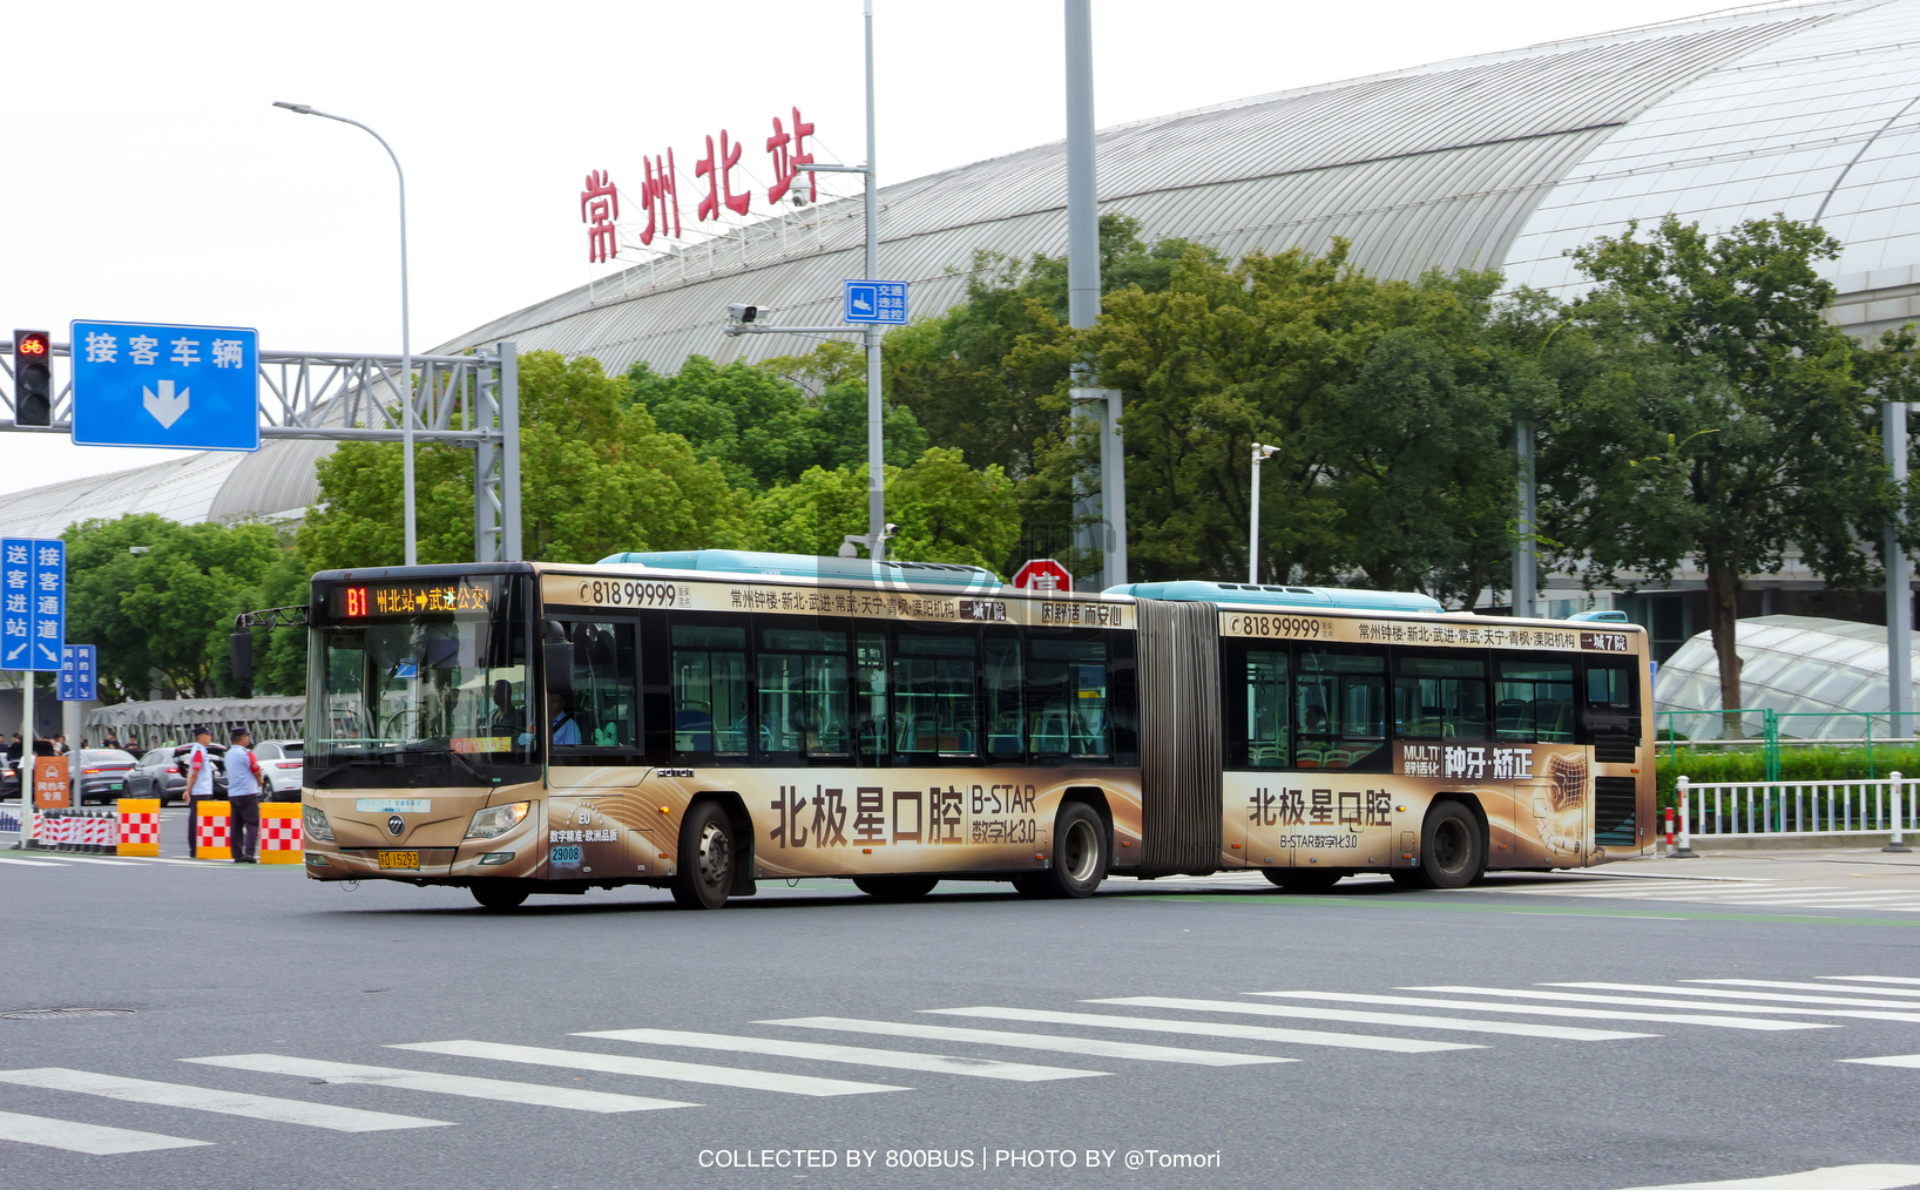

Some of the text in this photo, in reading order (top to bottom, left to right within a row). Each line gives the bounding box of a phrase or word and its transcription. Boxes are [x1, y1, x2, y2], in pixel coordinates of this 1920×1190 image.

[581, 106, 815, 263] 常州北站
[85, 332, 243, 369] 接客车辆
[6, 545, 28, 638] 送客进站
[37, 547, 60, 640] 接客通道
[347, 588, 367, 616] B1
[593, 581, 676, 606] 818 99999
[1243, 615, 1320, 638] 818 99999
[1404, 745, 1438, 760] MULTI
[1445, 746, 1533, 779] 种牙·矫正
[38, 782, 66, 791] 网约车
[972, 785, 1036, 815] B-STAR
[579, 813, 590, 825] EU
[770, 784, 963, 849] 北极星口腔
[1249, 787, 1392, 827] 北极星口腔
[972, 819, 1036, 844] 数字化3.0
[552, 847, 580, 861] 29008
